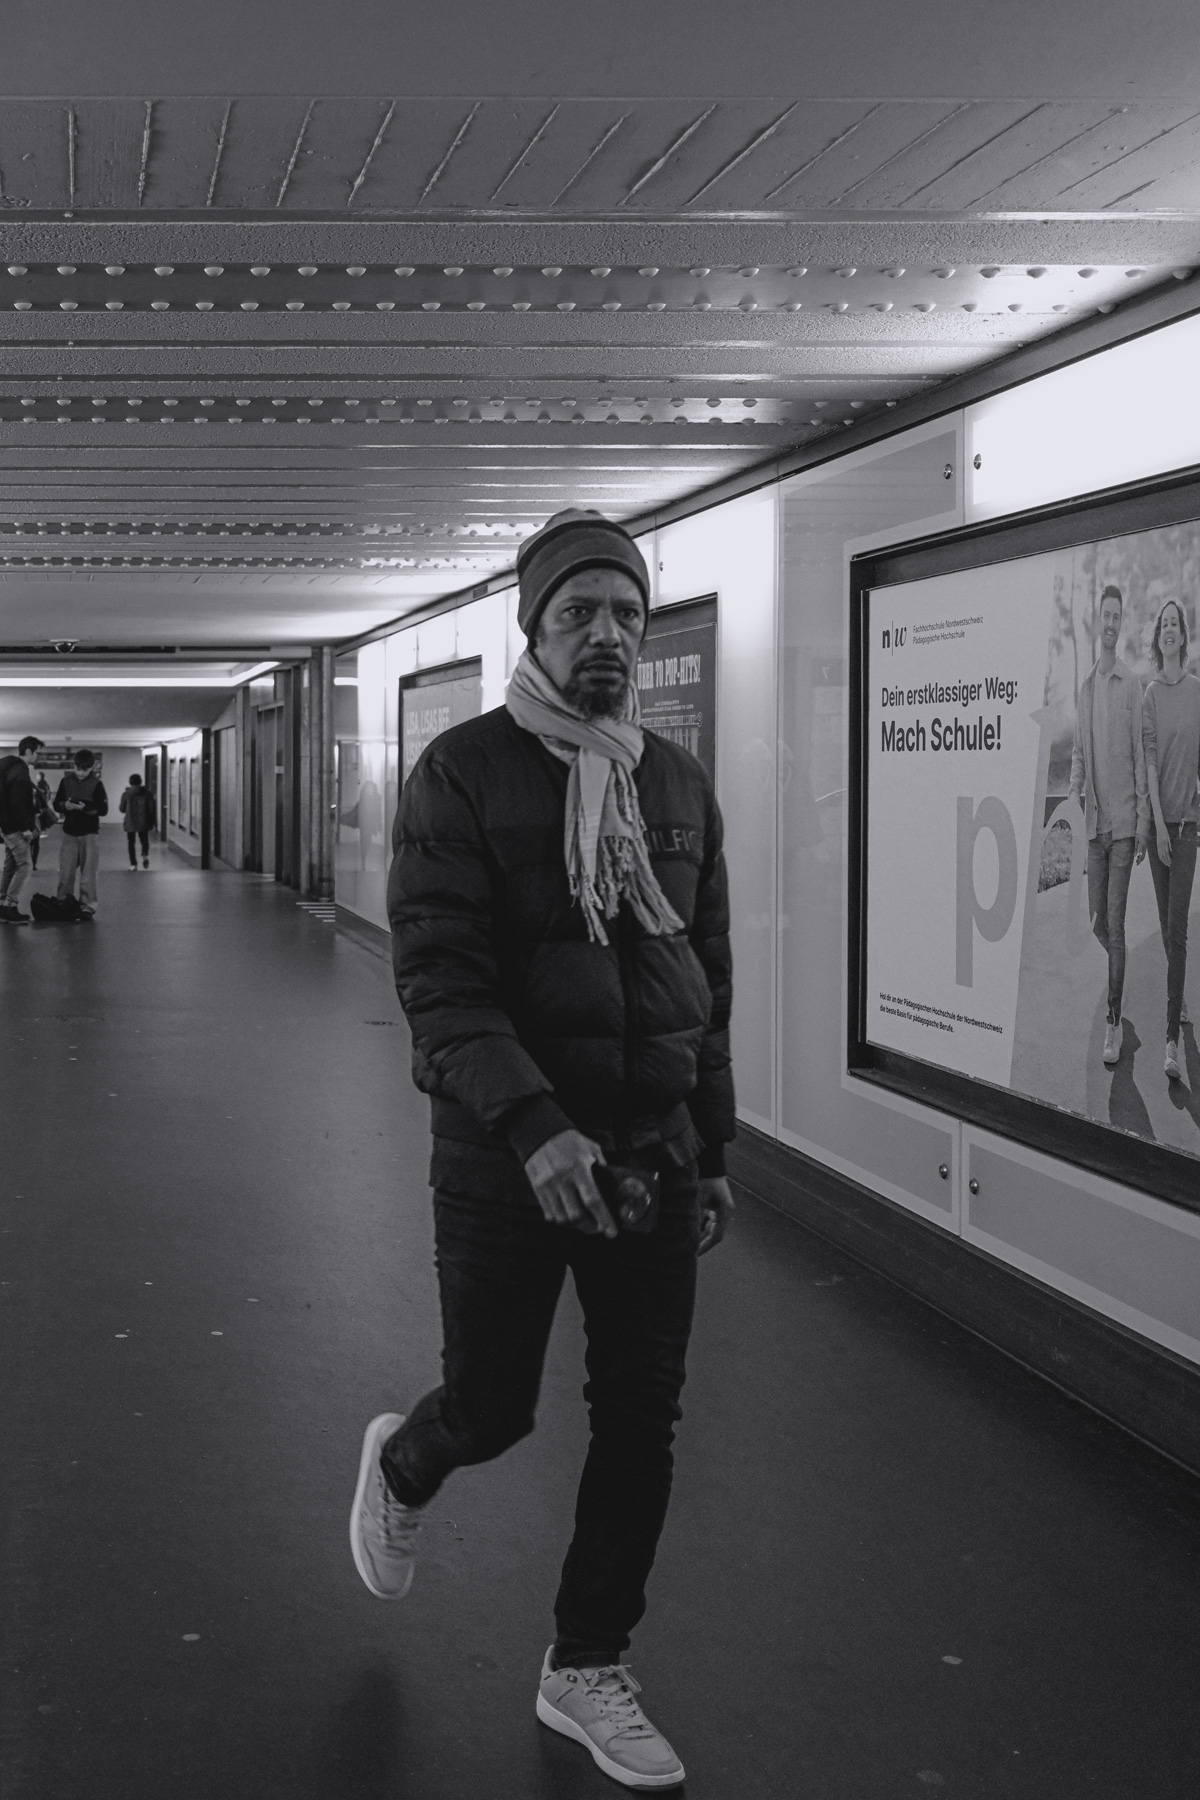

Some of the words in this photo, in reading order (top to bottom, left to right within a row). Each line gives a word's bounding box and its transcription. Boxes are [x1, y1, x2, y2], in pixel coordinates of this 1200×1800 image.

[913, 620, 945, 633] Fachhochschule
[941, 629, 965, 641] Hochschule
[665, 653, 701, 687] POP-HITS!
[881, 685, 905, 707] Dein
[906, 679, 982, 707] erstklassiger
[985, 676, 1018, 704] Weg:
[881, 719, 926, 752] Mach
[930, 714, 1001, 752] Schule!
[932, 1007, 955, 1020] Hochschule
[964, 1016, 1003, 1033] Nordwestschweiz
